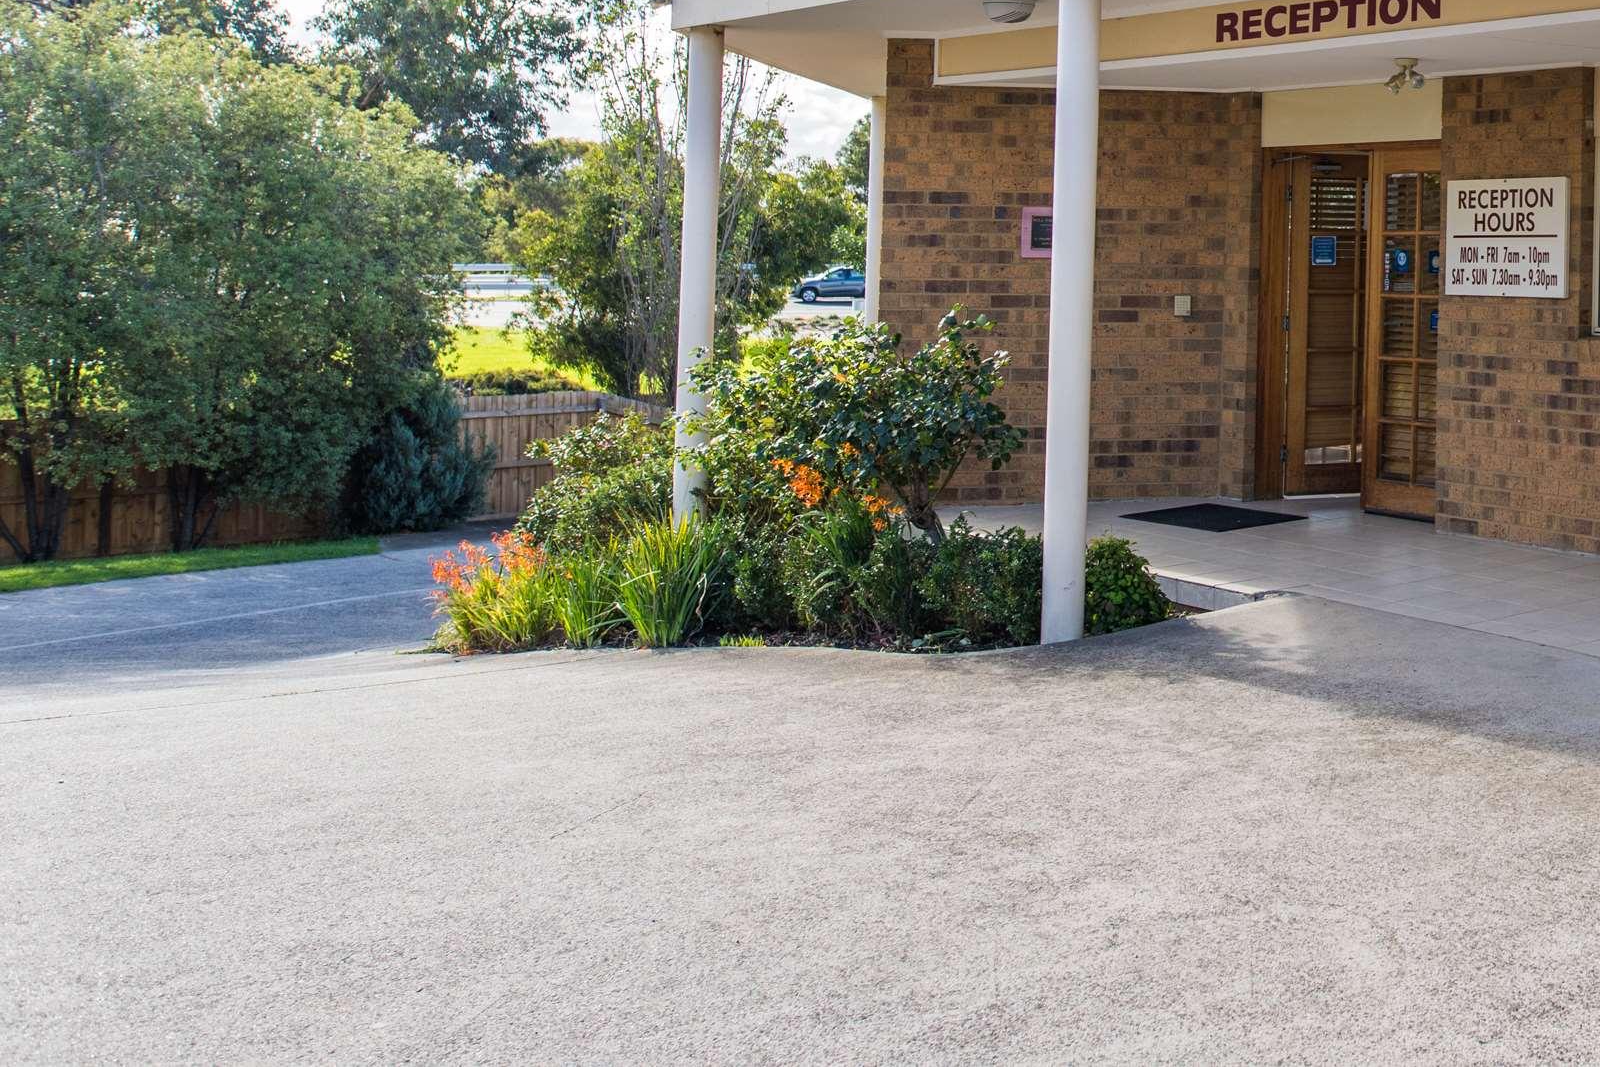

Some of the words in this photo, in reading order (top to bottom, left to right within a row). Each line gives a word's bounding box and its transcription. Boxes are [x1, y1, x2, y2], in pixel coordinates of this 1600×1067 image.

[1457, 187, 1554, 210] RECEPTION
[1473, 211, 1536, 233] HOURS
[1459, 246, 1479, 264] MON
[1486, 246, 1499, 264] FRI
[1502, 246, 1520, 264] 7am
[1528, 246, 1550, 268] 10pm
[1451, 268, 1465, 285] SAT
[1471, 268, 1488, 285] SUN
[1491, 268, 1521, 286] 7.30am
[1528, 268, 1558, 291] 9.30pm
